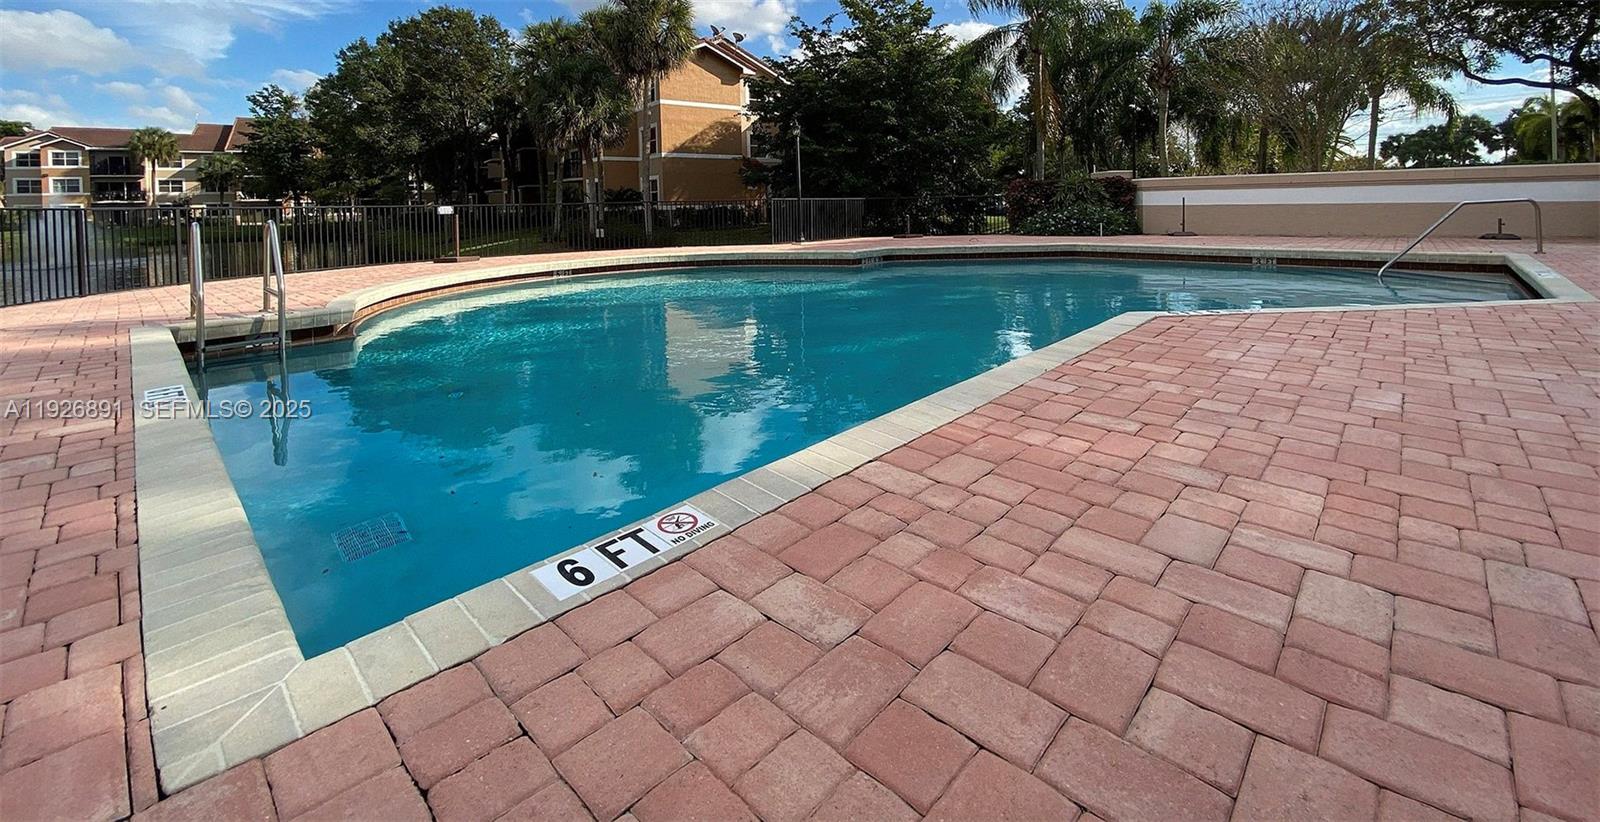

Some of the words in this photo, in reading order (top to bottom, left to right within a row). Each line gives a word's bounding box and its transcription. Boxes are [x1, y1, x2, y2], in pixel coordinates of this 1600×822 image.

[671, 535, 686, 545] NO
[685, 521, 715, 538] DIVING
[557, 558, 595, 587] 6
[594, 527, 660, 570] FT
